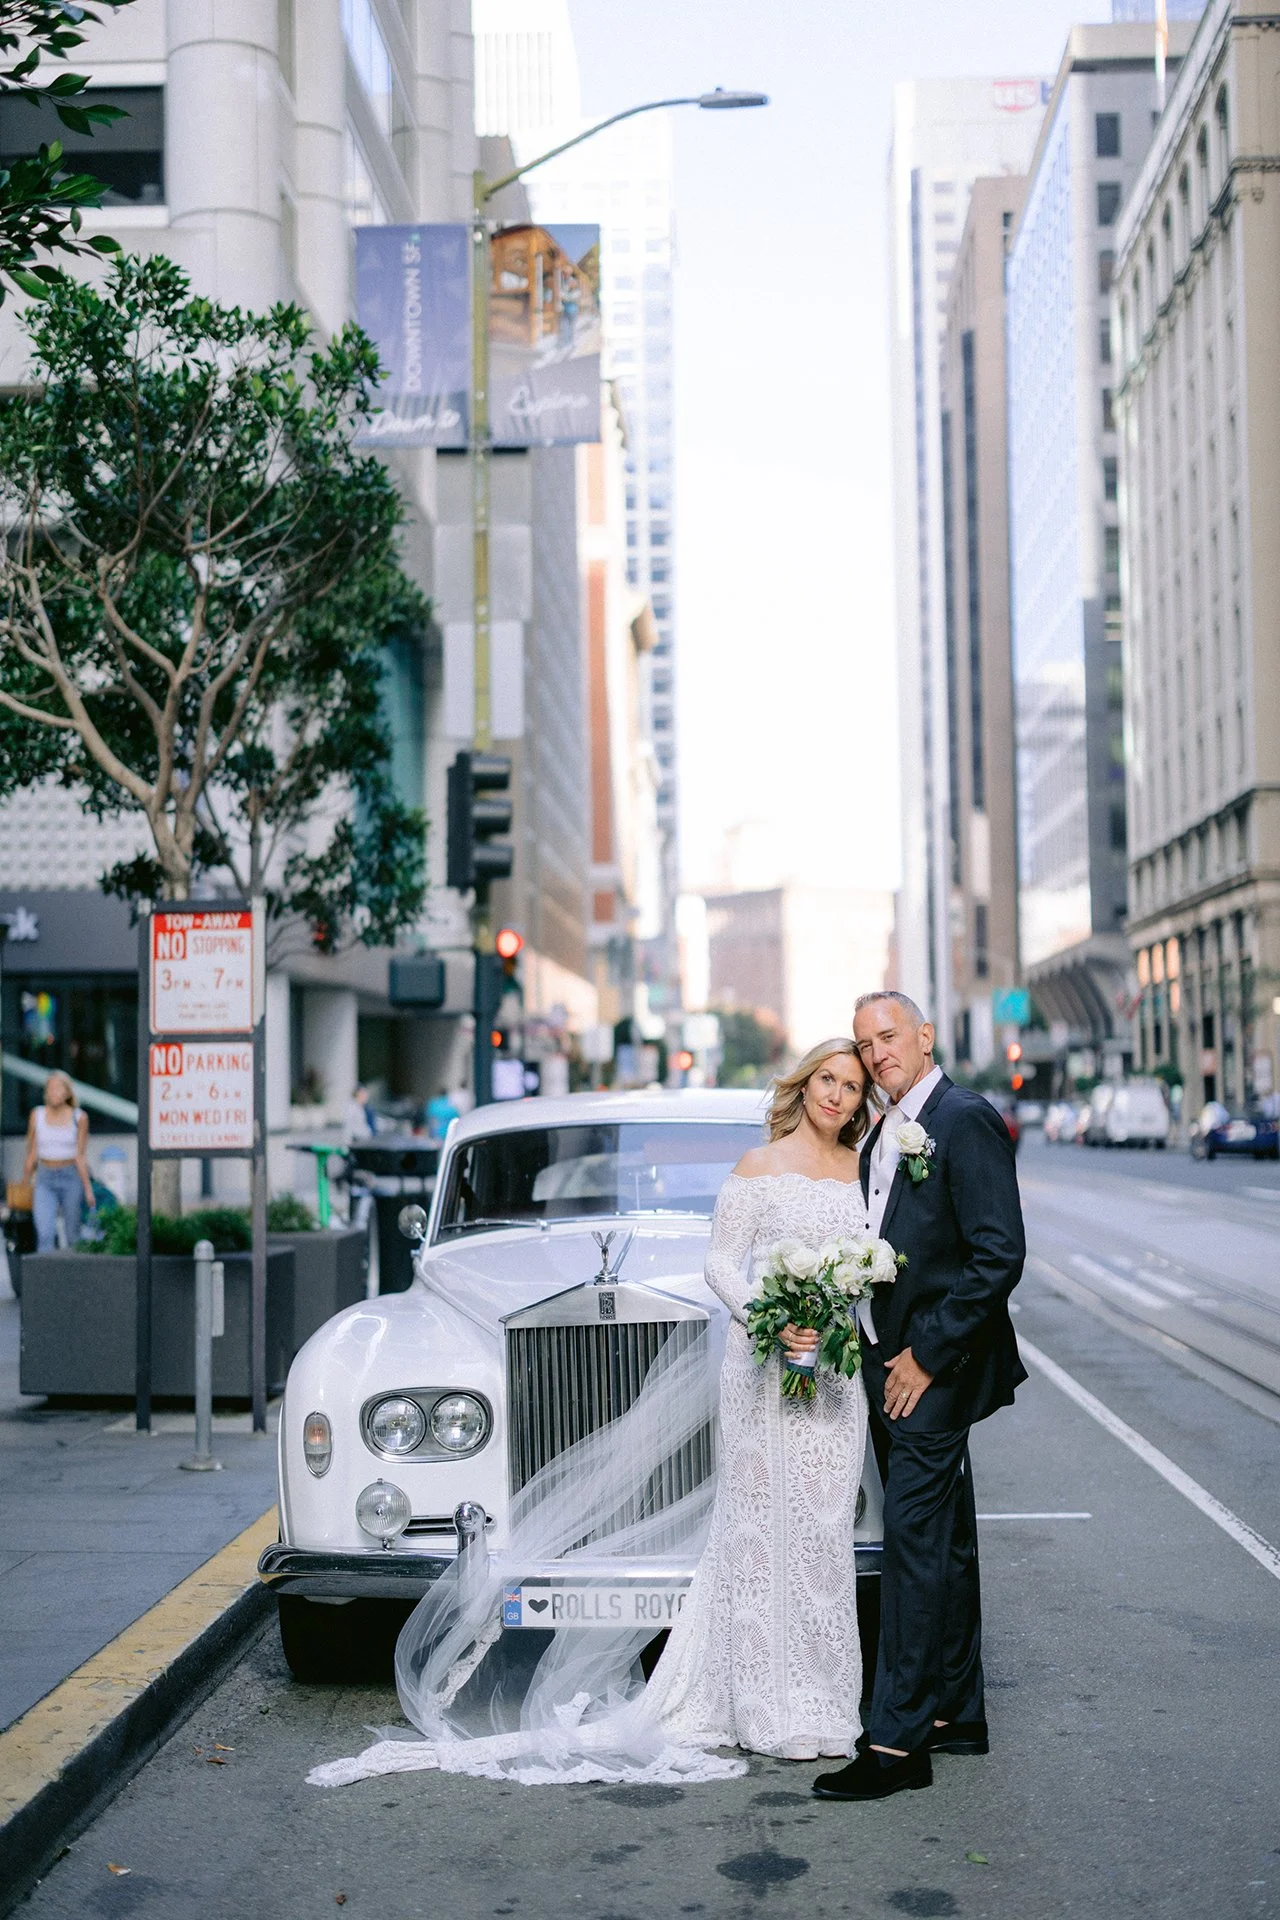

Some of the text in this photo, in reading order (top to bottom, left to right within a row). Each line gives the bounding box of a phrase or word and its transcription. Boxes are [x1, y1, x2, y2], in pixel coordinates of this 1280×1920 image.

[404, 268, 422, 392] DOWNTOWN
[164, 913, 241, 930] TOW-AWAY
[157, 932, 245, 960] NO STOPPING
[153, 1045, 250, 1075] NO PARKING
[160, 1109, 247, 1125] MON WED FRI
[507, 1612, 519, 1621] GB
[552, 1593, 622, 1620] ROLLS
